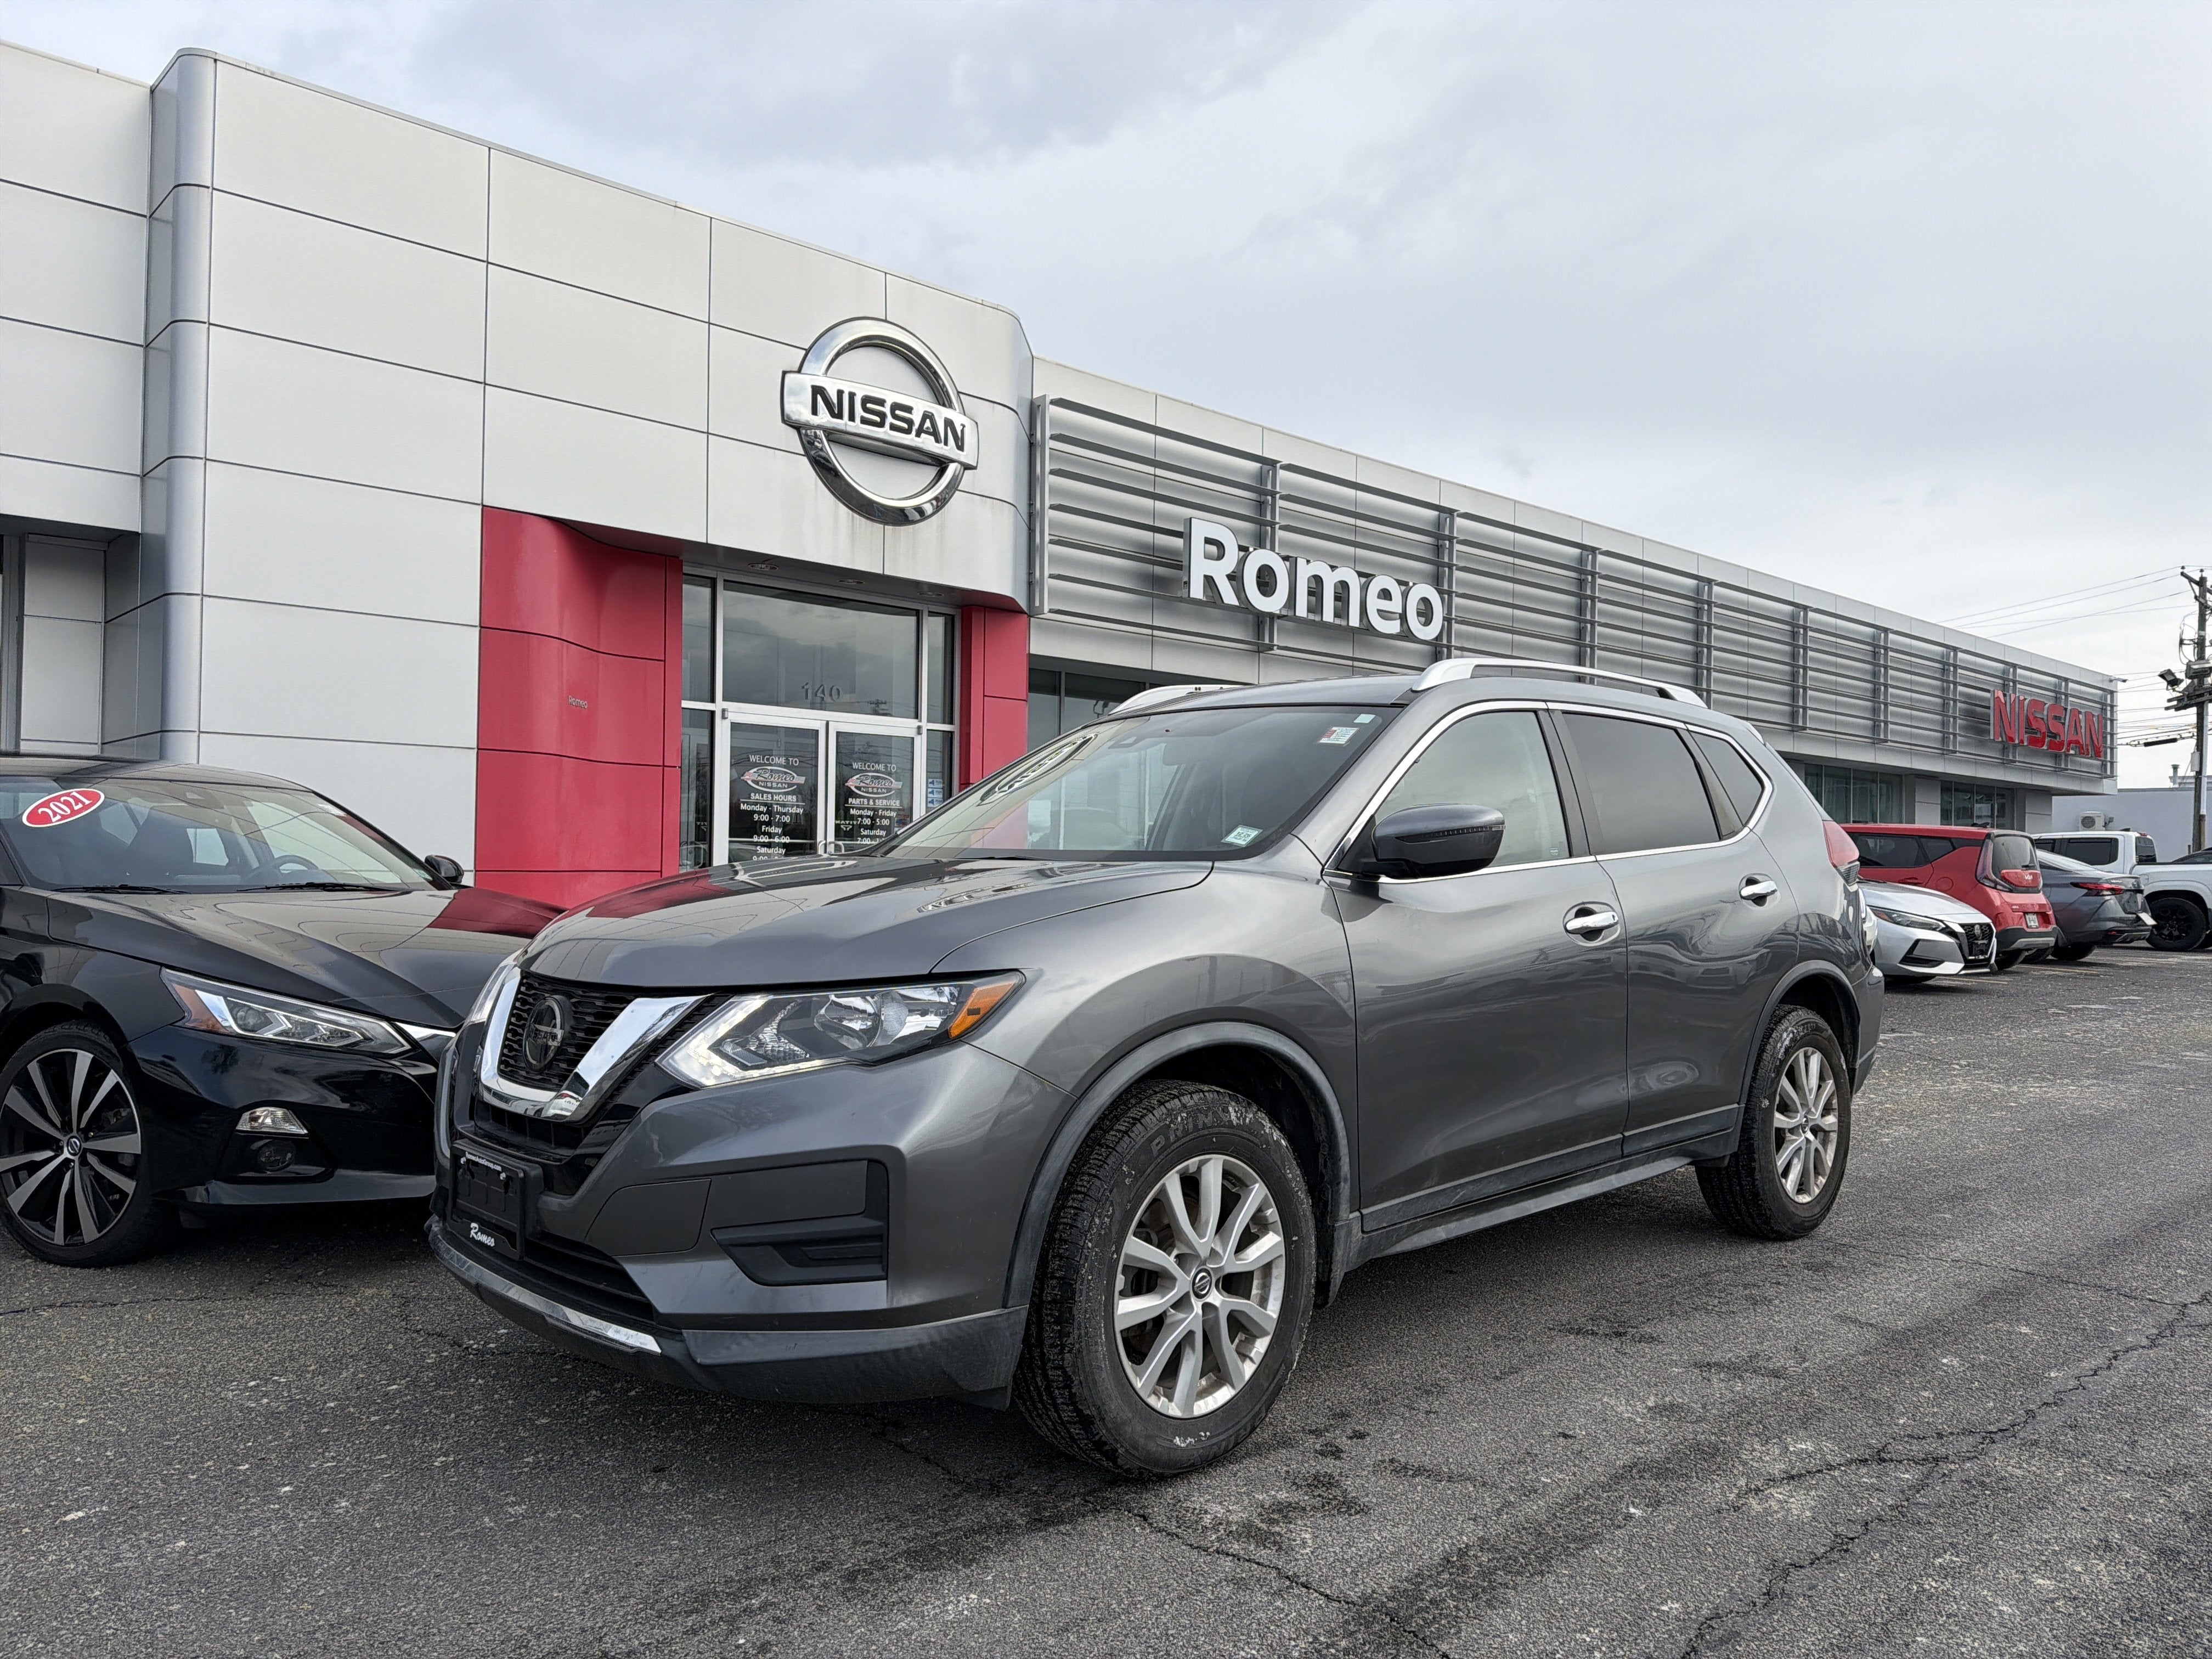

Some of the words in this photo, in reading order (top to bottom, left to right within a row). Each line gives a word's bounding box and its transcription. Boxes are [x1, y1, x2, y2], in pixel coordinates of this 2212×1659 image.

[810, 385, 966, 453] NISSAN
[1184, 517, 1444, 640] Romeo
[801, 682, 840, 702] 140
[568, 695, 588, 709] Romeo
[1991, 689, 2103, 759] NISSAN
[749, 754, 787, 765] WELCOME
[789, 758, 799, 766] TO
[852, 762, 885, 771] WELCOME
[754, 768, 795, 782] Romeo
[857, 774, 893, 787] Romeo
[38, 791, 93, 822] 2021
[740, 803, 768, 812] Monday
[773, 805, 804, 815] Thursday
[850, 808, 874, 817] Monday
[878, 809, 897, 818] Friday
[753, 814, 769, 822] 9:00
[761, 825, 782, 834] Friday
[860, 828, 887, 837] Saturday
[757, 846, 786, 855] Saturday
[470, 1222, 495, 1247] Romeo
